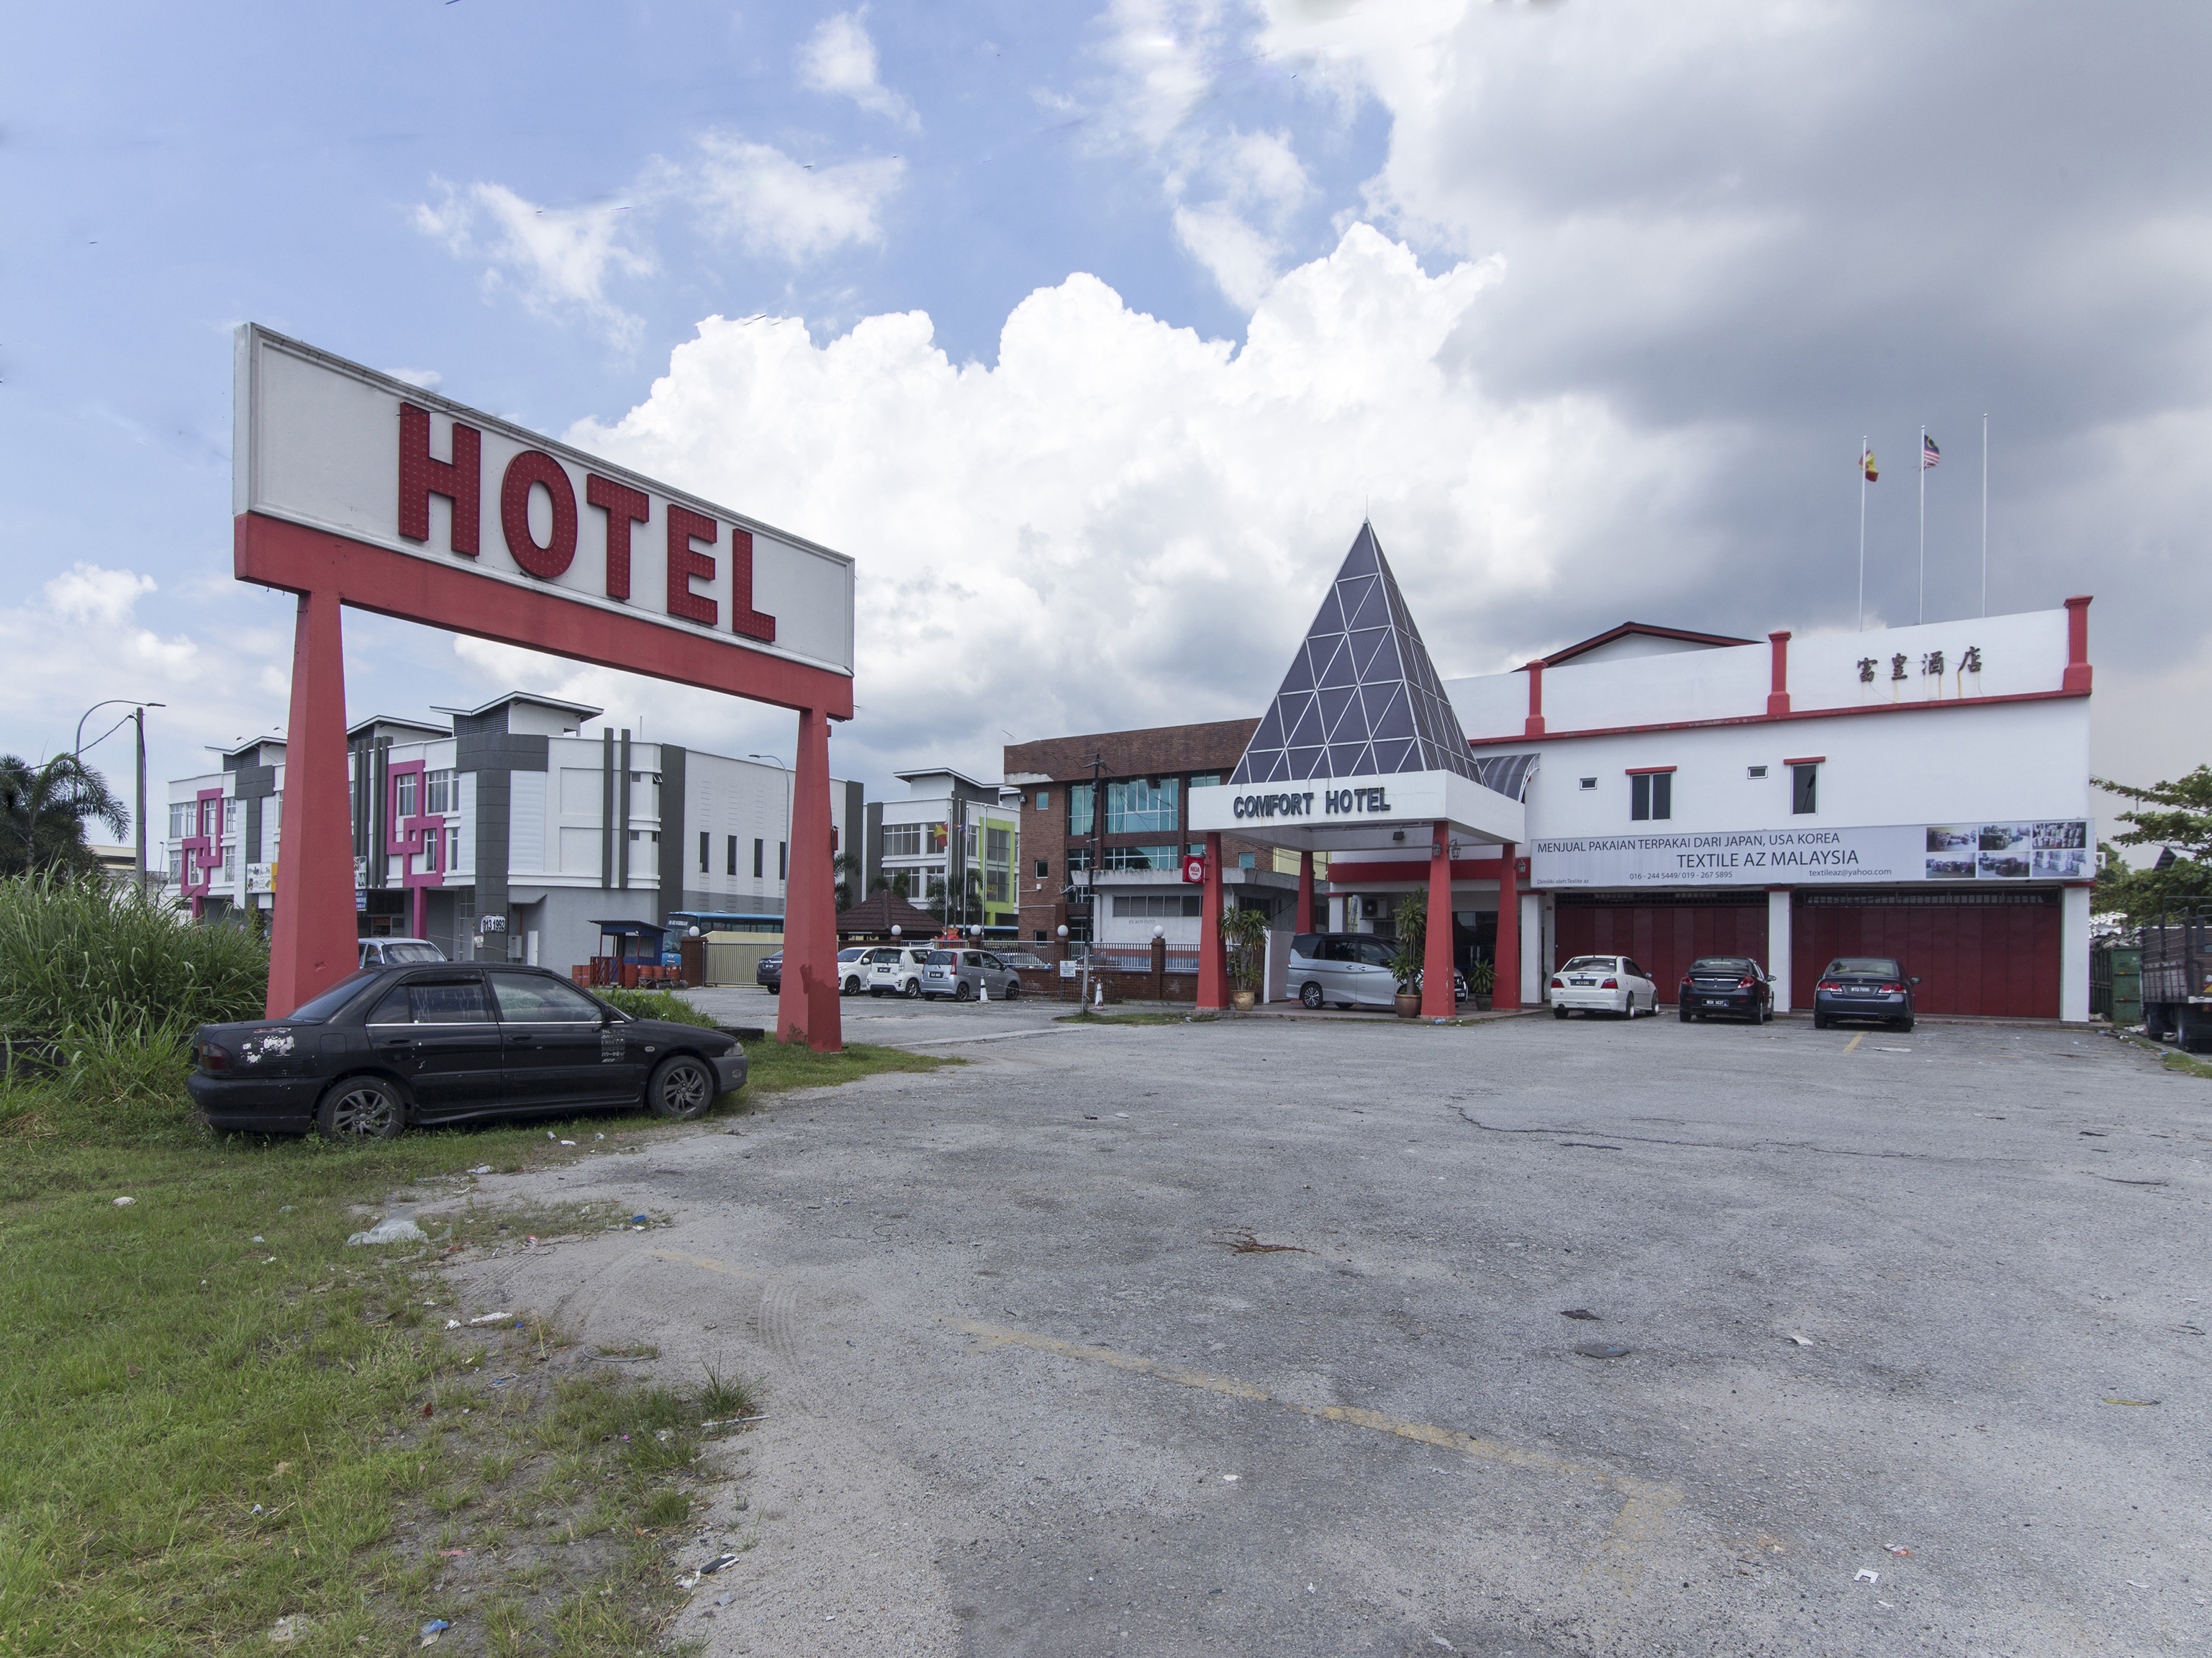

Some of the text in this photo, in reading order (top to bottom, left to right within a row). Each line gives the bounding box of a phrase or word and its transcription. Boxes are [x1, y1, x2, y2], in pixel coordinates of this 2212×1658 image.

[399, 402, 776, 642] HOTEL
[1857, 646, 1982, 682] 富皇酒店
[1233, 787, 1391, 818] COMFORT HOTEL
[1538, 833, 1840, 853] MENJUAL PAKAIAN TERPAKAI DARI JAPAN, USA KOREA
[1677, 850, 1859, 868] TEXTILE AZ MALAYSIA
[1809, 869, 1892, 877] textileaz@yahoo.com
